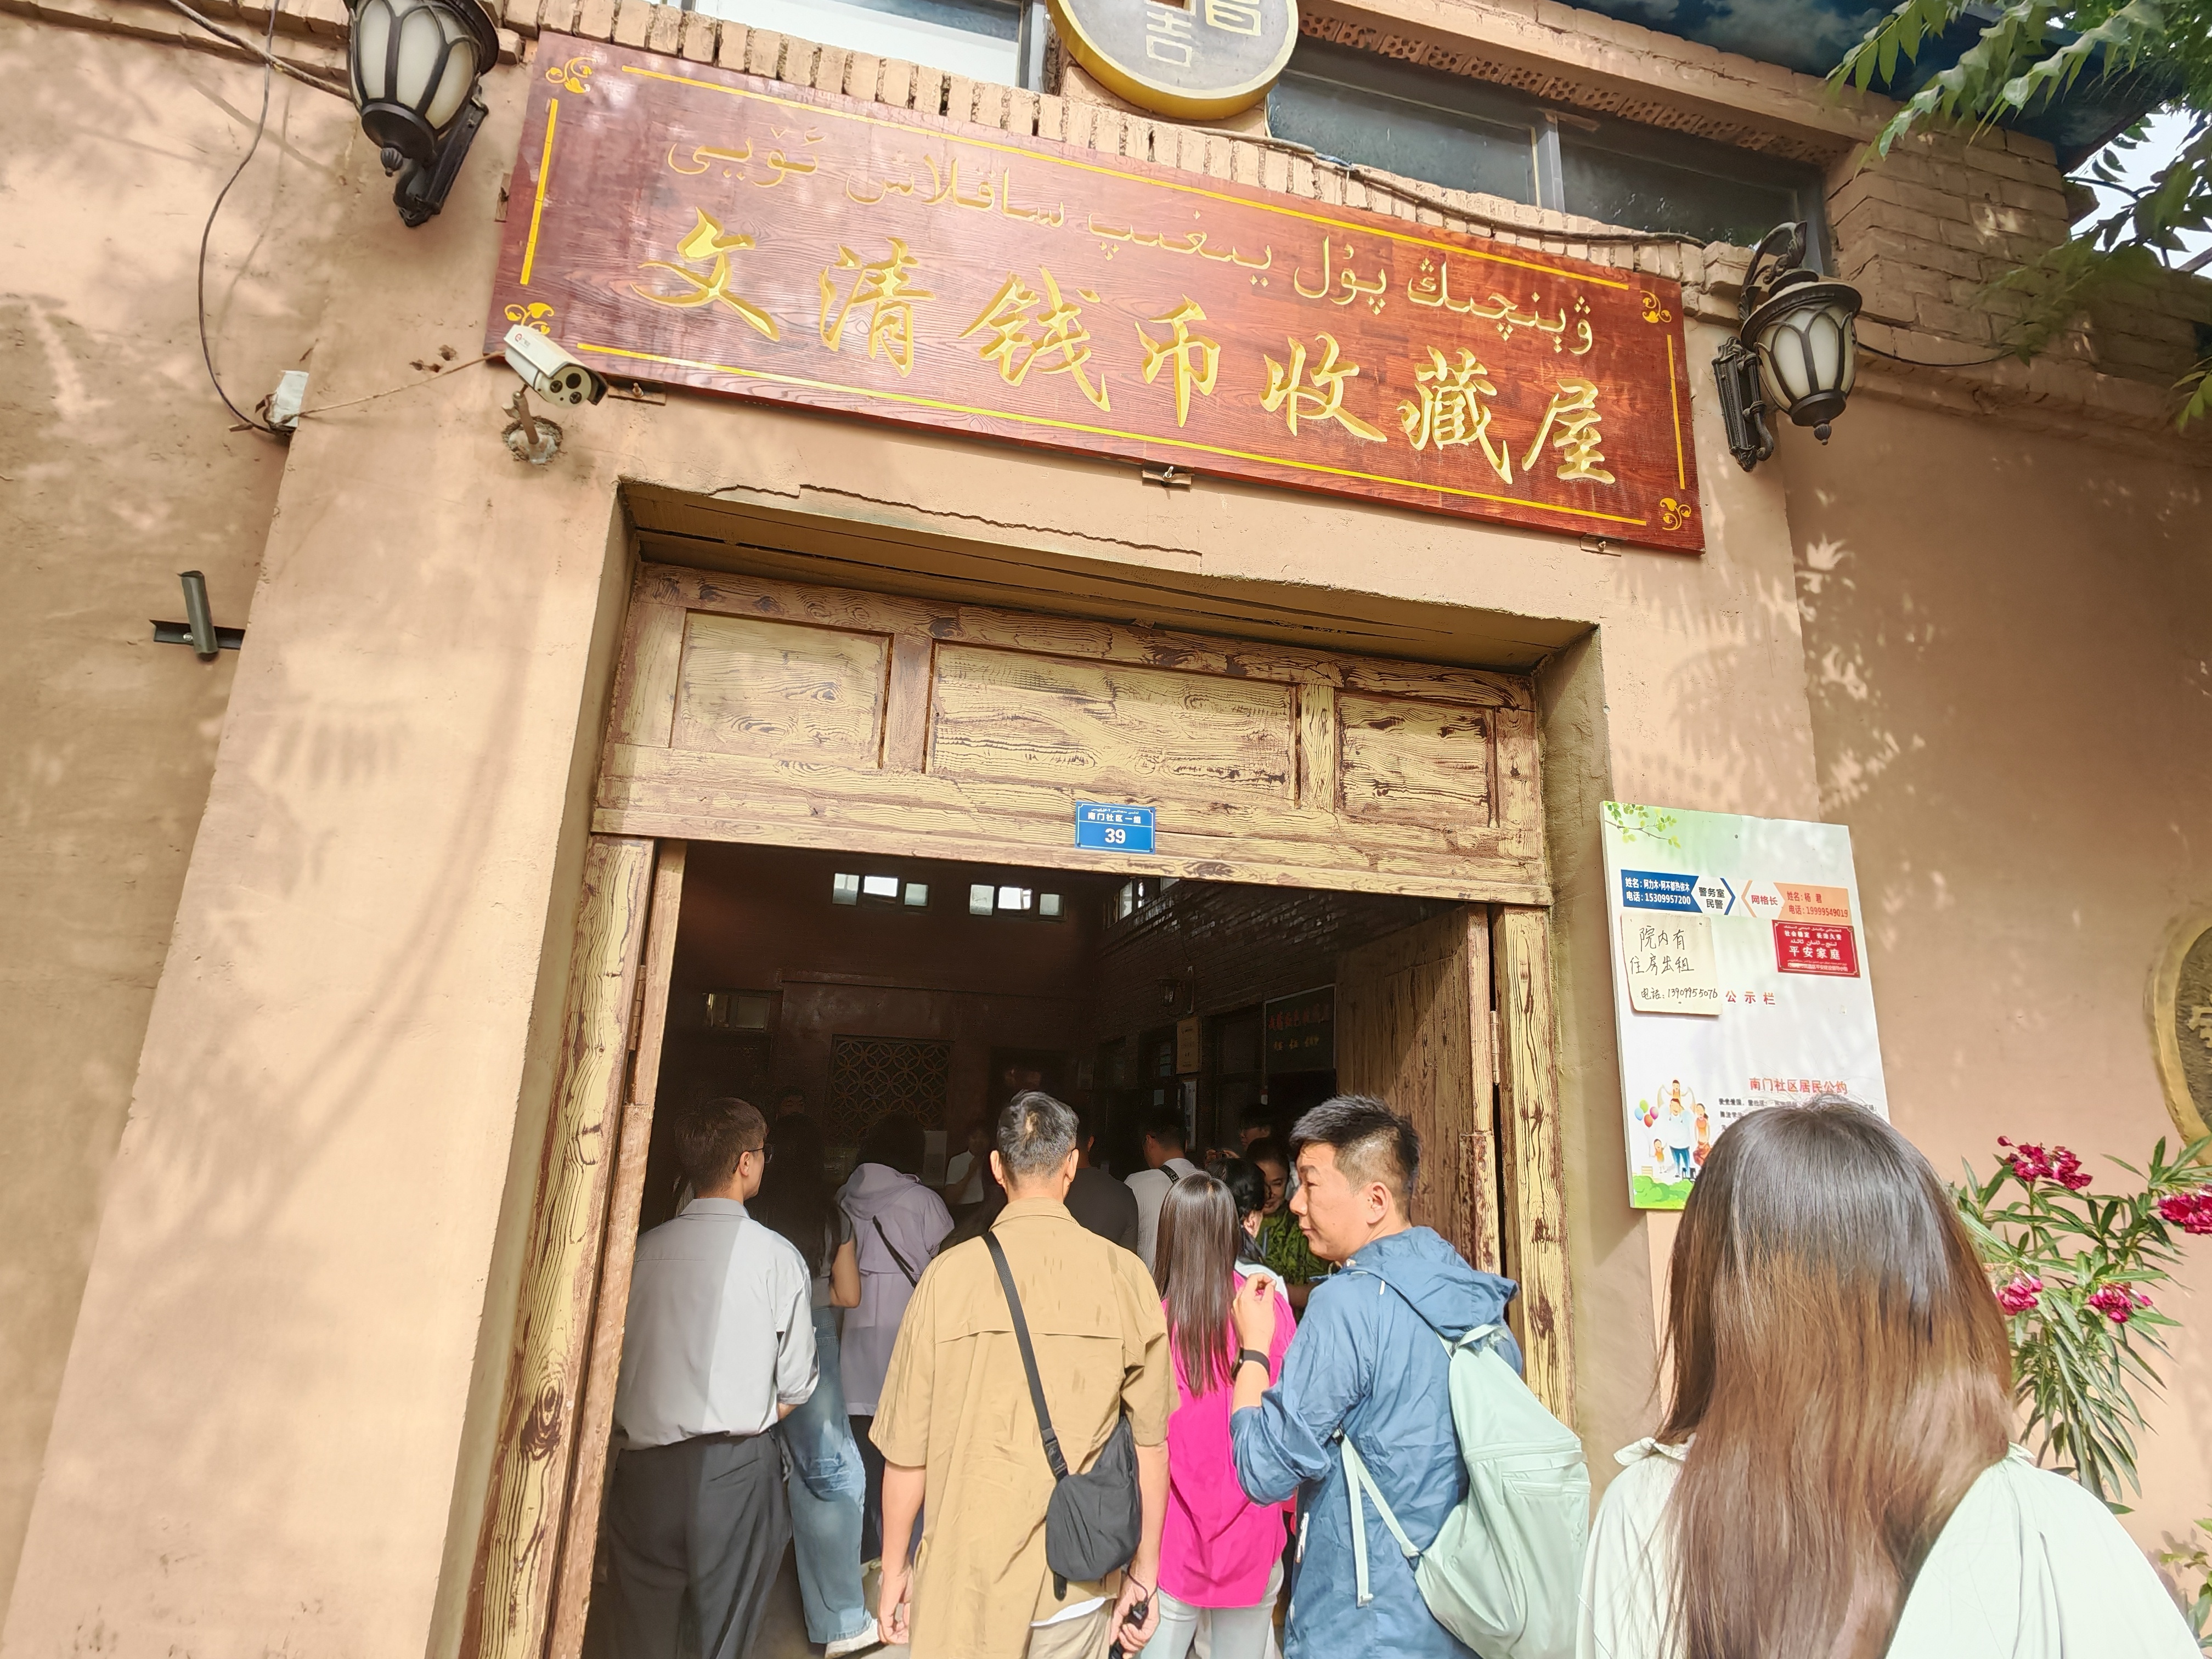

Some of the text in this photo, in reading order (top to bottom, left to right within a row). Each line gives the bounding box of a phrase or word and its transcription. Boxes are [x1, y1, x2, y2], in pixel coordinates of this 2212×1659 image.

[1294, 235, 1387, 315] پۇل
[630, 206, 1616, 485] 文清钱币收藏屋
[1087, 811, 1142, 824] 南门社区一组
[1104, 827, 1126, 844] 39
[1698, 887, 1725, 899] 警务室
[1751, 894, 1779, 906] 网格长
[1706, 898, 1724, 910] 民警
[1639, 925, 1685, 952] 院内有
[1784, 930, 1842, 941] 社会稳定 长治久安
[1788, 945, 1841, 960] 平安家庭
[1630, 952, 1695, 976] 住房出租
[1725, 990, 1776, 1006] 公示栏
[1748, 1076, 1848, 1094] 南门社区居民公约
